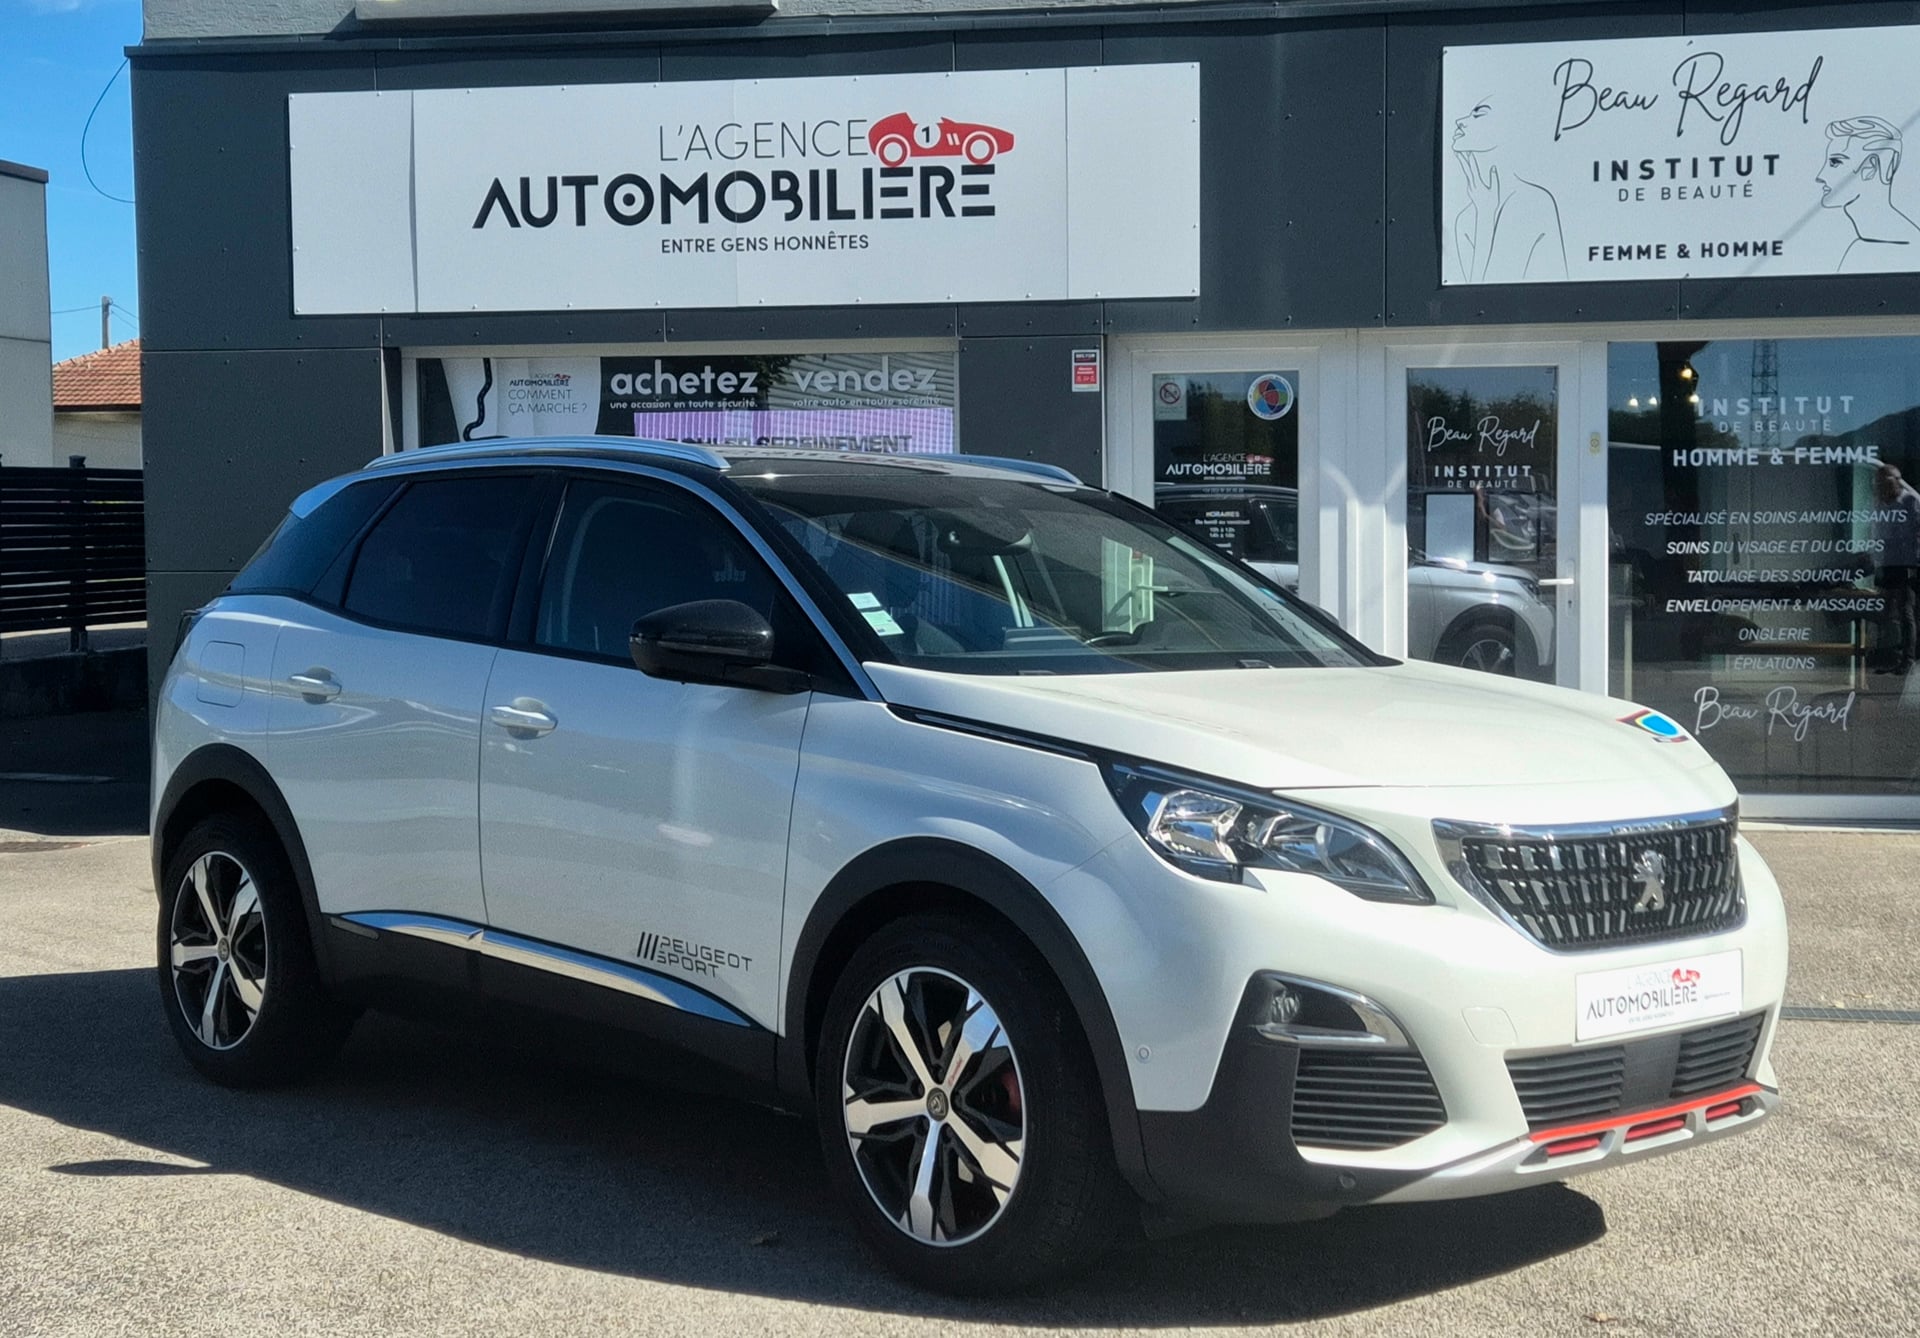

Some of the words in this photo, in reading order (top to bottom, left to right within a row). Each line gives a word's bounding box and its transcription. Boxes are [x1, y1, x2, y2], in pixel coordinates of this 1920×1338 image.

[1554, 58, 1659, 141] Beau
[1673, 52, 1823, 145] Regard
[659, 119, 868, 161] L'AGENCE
[921, 126, 930, 143] 1
[1593, 154, 1780, 182] INSTITUT
[1619, 187, 1645, 202] DE
[1661, 180, 1754, 200] BEAUTÉ
[661, 237, 715, 253] ENTRE
[722, 236, 768, 252] GENS
[775, 231, 869, 251] HONNÊTES
[1588, 244, 1667, 261] FEMME
[1677, 243, 1691, 259] &
[1701, 240, 1784, 258] HOMME
[610, 359, 758, 395] achetez
[792, 355, 937, 392] vendez
[508, 389, 573, 400] COMMENT
[610, 401, 627, 409] une
[631, 399, 670, 409] occasion
[689, 400, 713, 408] toute
[508, 402, 524, 417] ÇA
[527, 402, 578, 414] MARCHE
[581, 402, 588, 413] ?
[1697, 396, 1854, 417] INSTITUT
[1719, 422, 1741, 433] DE
[1755, 416, 1832, 432] BEAUTÉ
[1427, 416, 1472, 452] Beau
[1477, 415, 1540, 456] Regard
[1203, 453, 1246, 462] L'AGENCE
[1673, 448, 1759, 466] HOMME
[1770, 448, 1784, 465] &
[1795, 446, 1879, 465] FEMME
[1434, 465, 1531, 477] INSTITUT
[1448, 480, 1462, 489] DE
[1470, 479, 1517, 489] BEAUTÉ
[1645, 508, 1726, 526] SPÉCIALISÉ
[1729, 511, 1749, 524] EN
[1752, 510, 1796, 524] SOINS
[1799, 509, 1908, 524] AMINCISSANTS
[1666, 541, 1710, 554] SOINS
[1711, 541, 1732, 554] DU
[1737, 541, 1787, 554] VISAGE
[1790, 540, 1809, 553] ET
[1811, 540, 1832, 553] DU
[1835, 539, 1885, 552] CORPS
[1687, 570, 1757, 583] TATOUAGE
[1759, 570, 1789, 582] DES
[1791, 569, 1864, 582] SOURCILS
[1666, 599, 1789, 613] ENVELOPPEMENT
[1793, 599, 1801, 611] &
[1806, 598, 1885, 612] MASSAGES
[1738, 627, 1811, 641] ONGLERIE
[1694, 686, 1758, 735] Beau
[1766, 686, 1856, 741] Regard
[660, 936, 752, 971] PEUGEOT
[657, 950, 719, 978] SPORT
